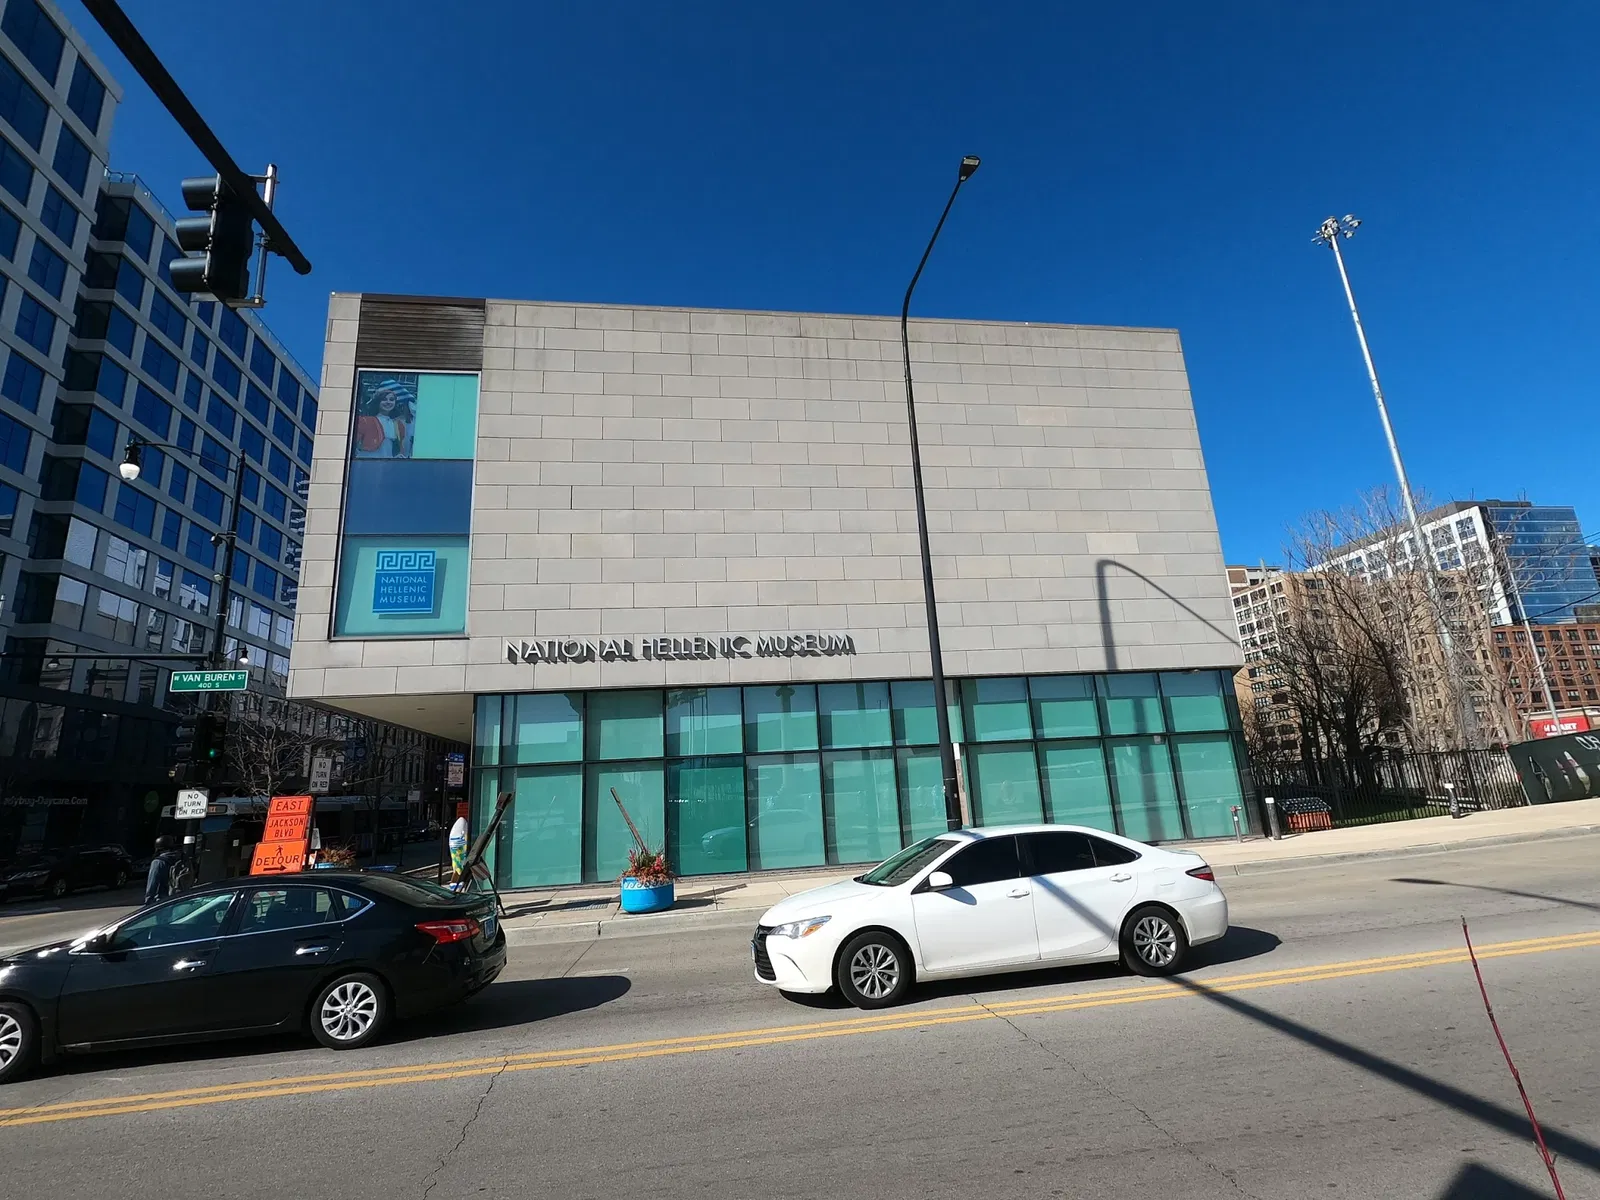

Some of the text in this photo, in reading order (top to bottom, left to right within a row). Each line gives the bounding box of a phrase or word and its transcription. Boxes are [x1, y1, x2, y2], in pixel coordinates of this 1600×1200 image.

[381, 576, 428, 584] NATIONAL
[380, 585, 427, 594] HELLENIC
[379, 595, 426, 604] MUSEUM
[504, 633, 853, 661] NATIONAL HELLENIC MUSEUM
[182, 674, 201, 682] VAN
[204, 673, 235, 682] BUREN
[318, 761, 327, 769] NO
[315, 771, 327, 779] TURN
[275, 800, 304, 811] EAST
[269, 817, 305, 828] JACKSON
[274, 828, 294, 838] BLVD
[255, 854, 300, 867] DETOUR
